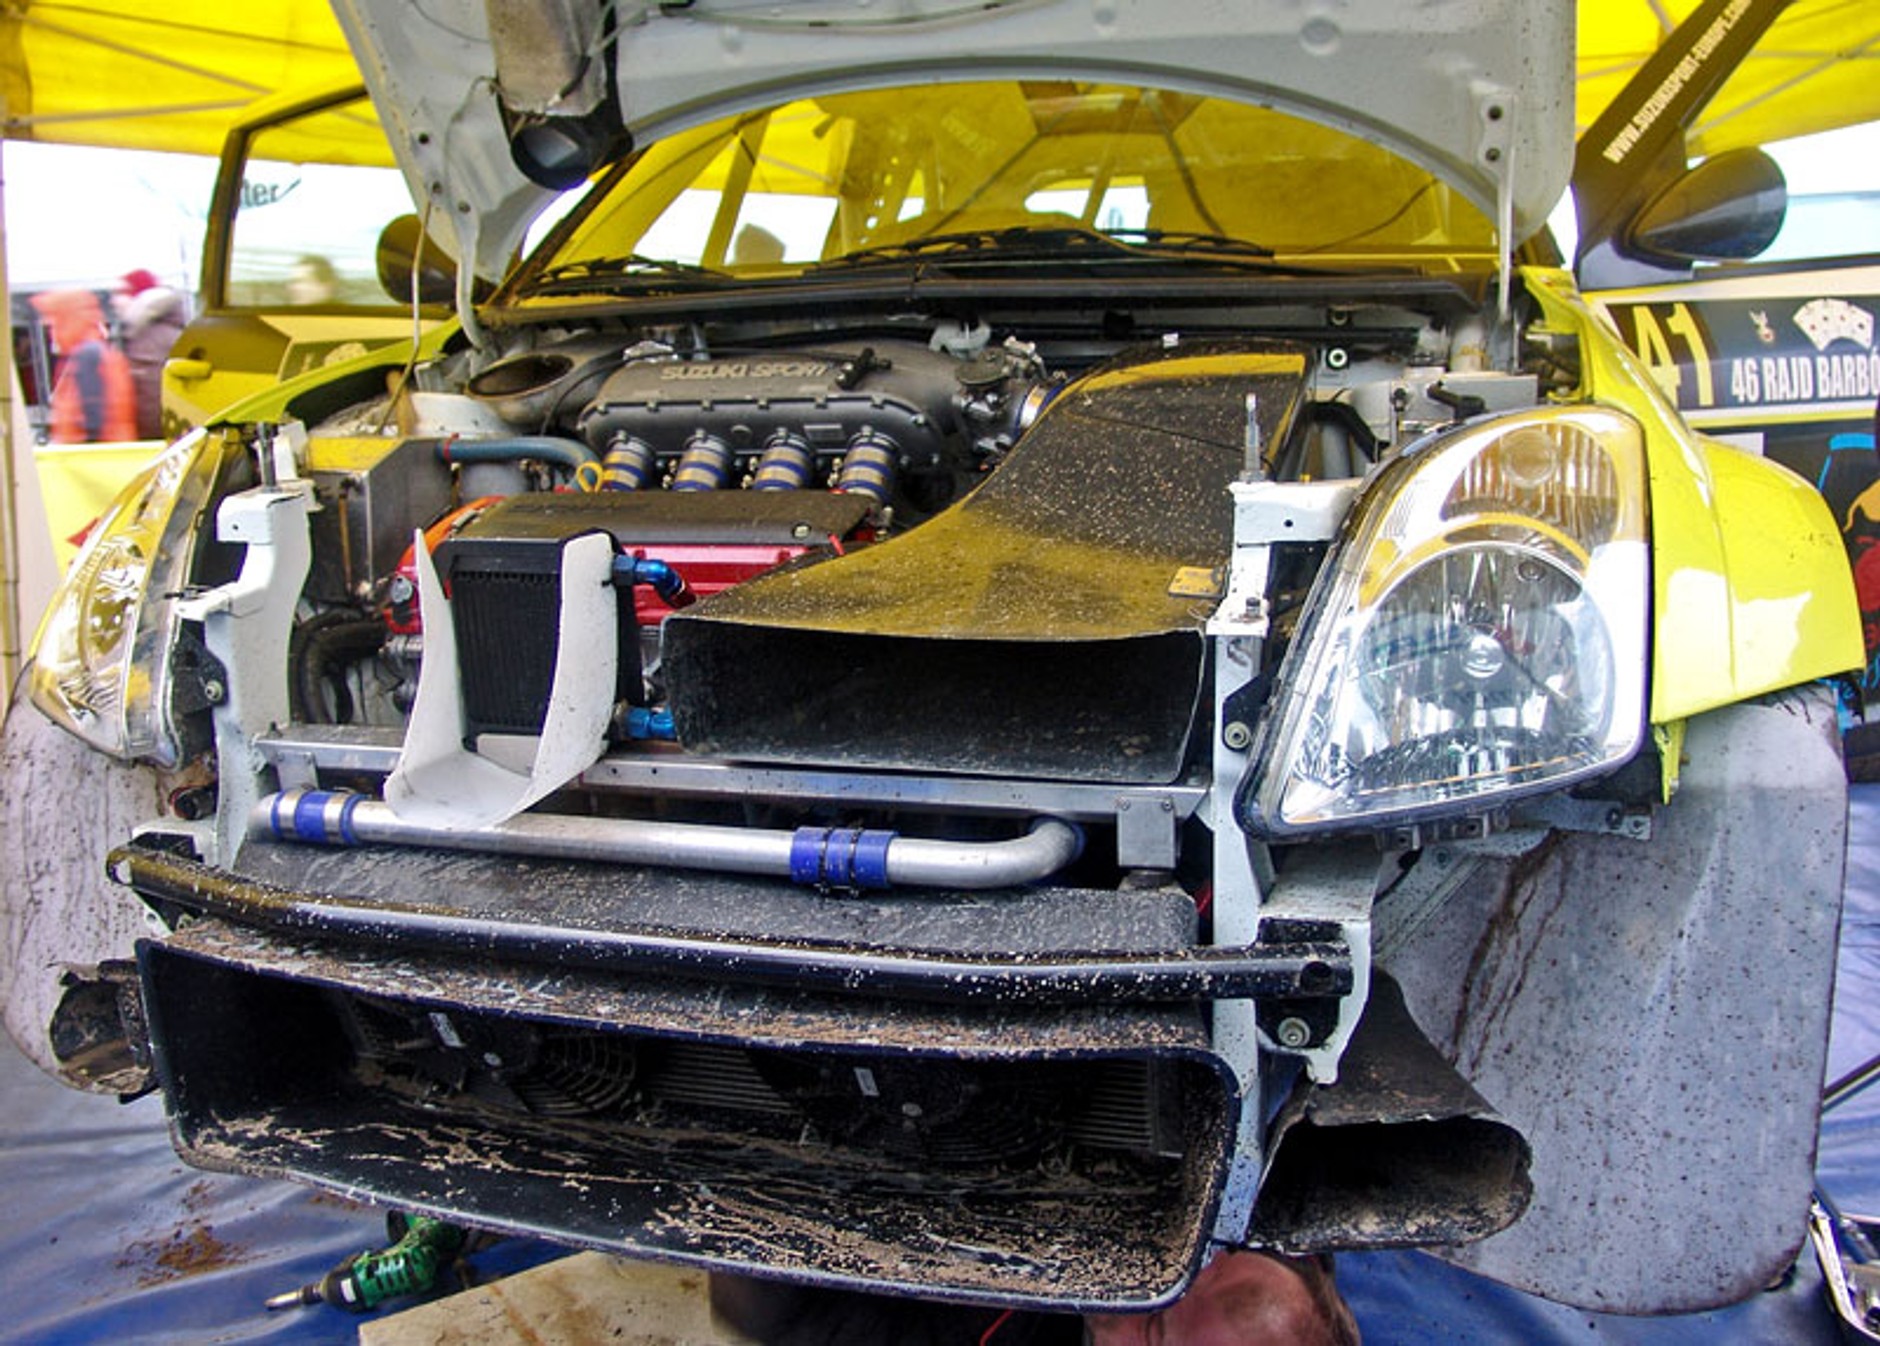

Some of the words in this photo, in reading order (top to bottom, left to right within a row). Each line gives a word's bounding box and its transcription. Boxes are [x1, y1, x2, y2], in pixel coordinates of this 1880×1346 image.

[660, 364, 748, 381] SUZUKI
[752, 362, 829, 379] SPORT
[1632, 303, 1714, 408] 41
[1731, 357, 1760, 403] 46
[1762, 356, 1814, 402] RAJD
